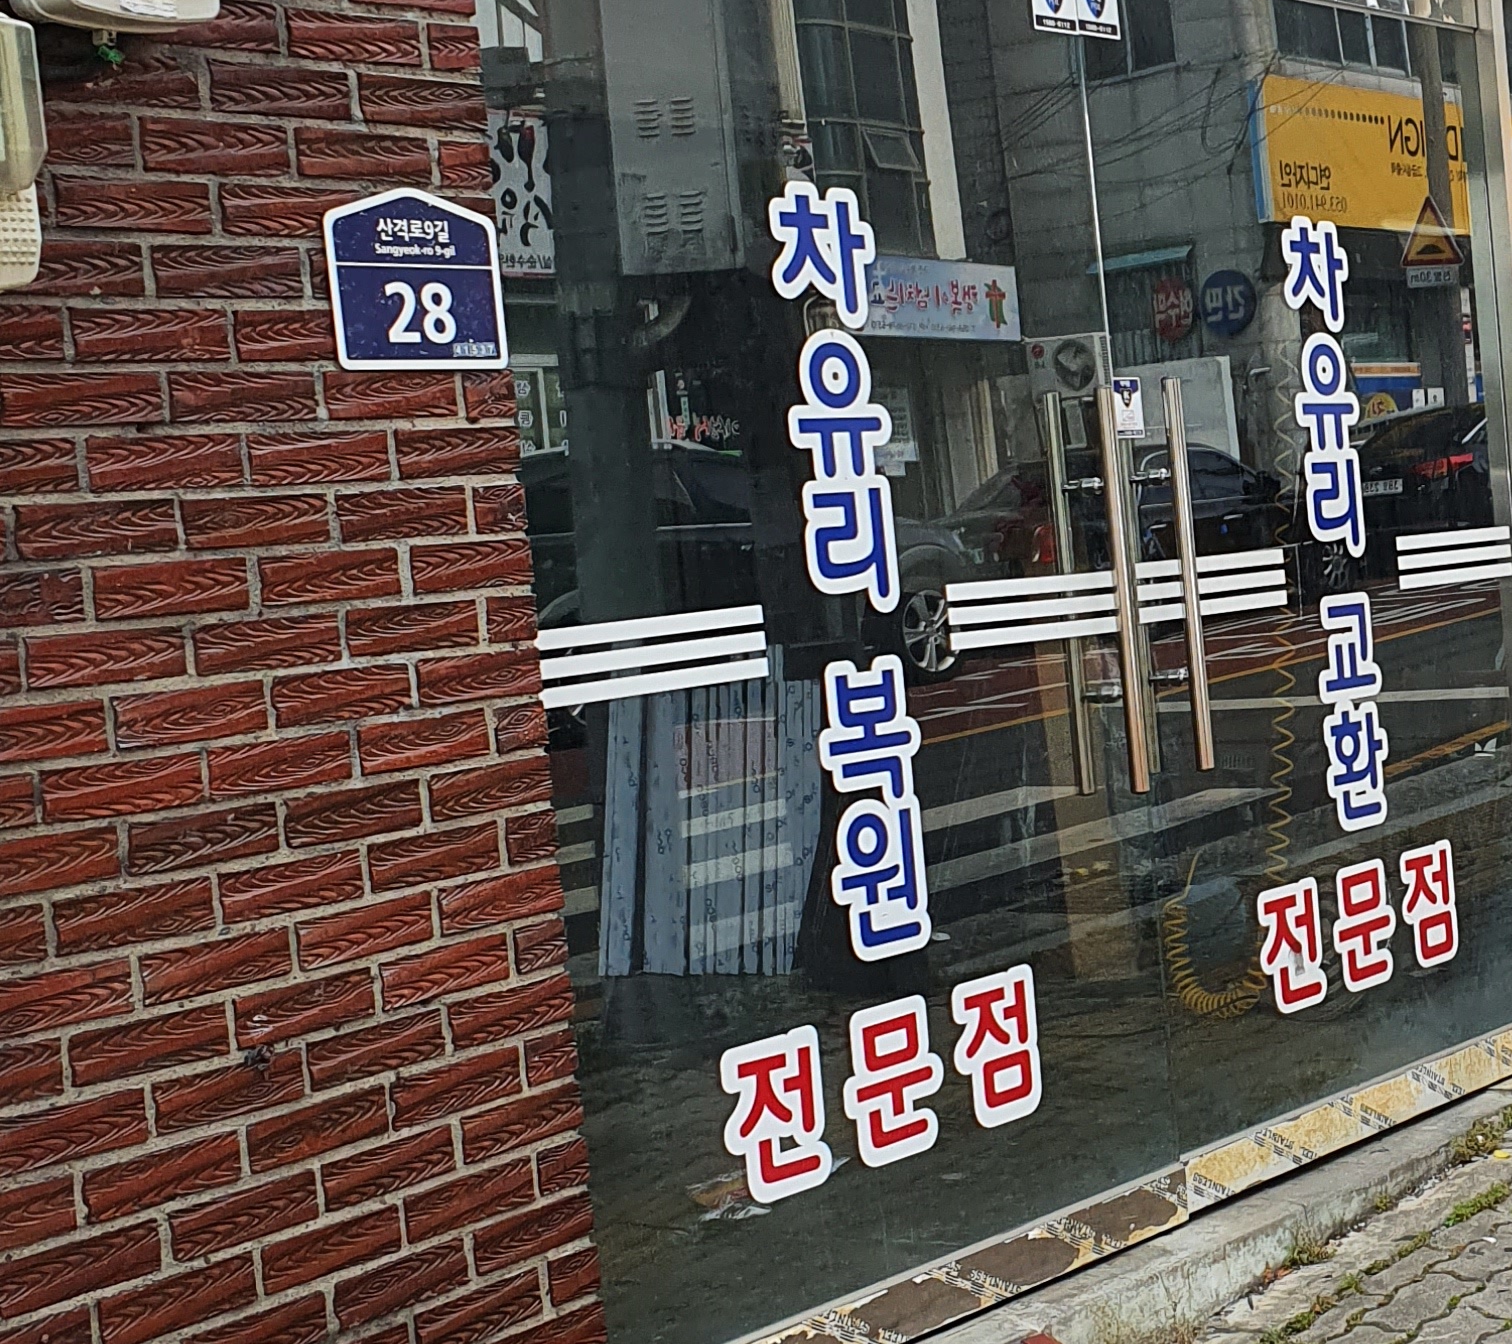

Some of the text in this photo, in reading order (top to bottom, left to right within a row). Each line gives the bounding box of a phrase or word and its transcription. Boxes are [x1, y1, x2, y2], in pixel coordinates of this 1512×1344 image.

[374, 242, 457, 259] Sangyeok-ro 9-gil
[375, 217, 451, 244] 산격로9길
[384, 280, 457, 345] 28
[768, 178, 934, 963] 차유리 복원
[1280, 214, 1389, 833] 차유리 교환
[1254, 838, 1460, 1014] 전문점
[719, 962, 1043, 1205] 전문점
